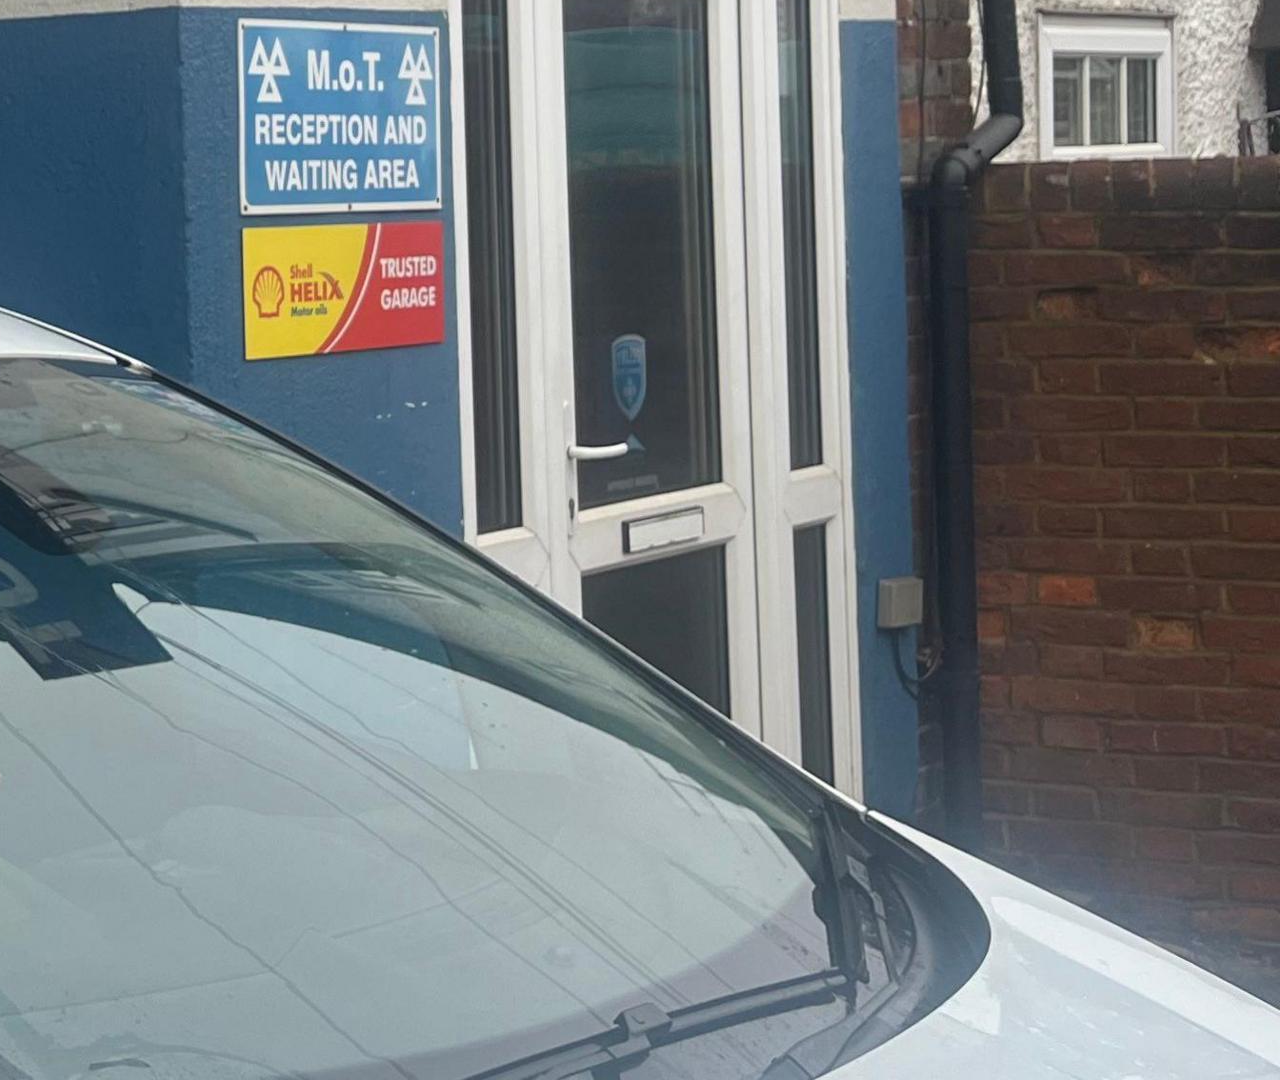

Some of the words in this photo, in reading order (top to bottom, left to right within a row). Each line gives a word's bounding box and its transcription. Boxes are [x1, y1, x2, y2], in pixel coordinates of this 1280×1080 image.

[307, 49, 384, 92] M.o.T.
[254, 114, 378, 146] RECEPTION
[384, 115, 426, 145] AND
[265, 159, 358, 192] WAITING
[364, 159, 420, 190] AREA
[290, 263, 313, 279] Shell
[380, 255, 436, 279] TRUSTED
[290, 272, 344, 303] HELIX
[380, 286, 436, 310] GARAGE
[290, 306, 313, 317] Motor
[315, 304, 328, 315] oils
